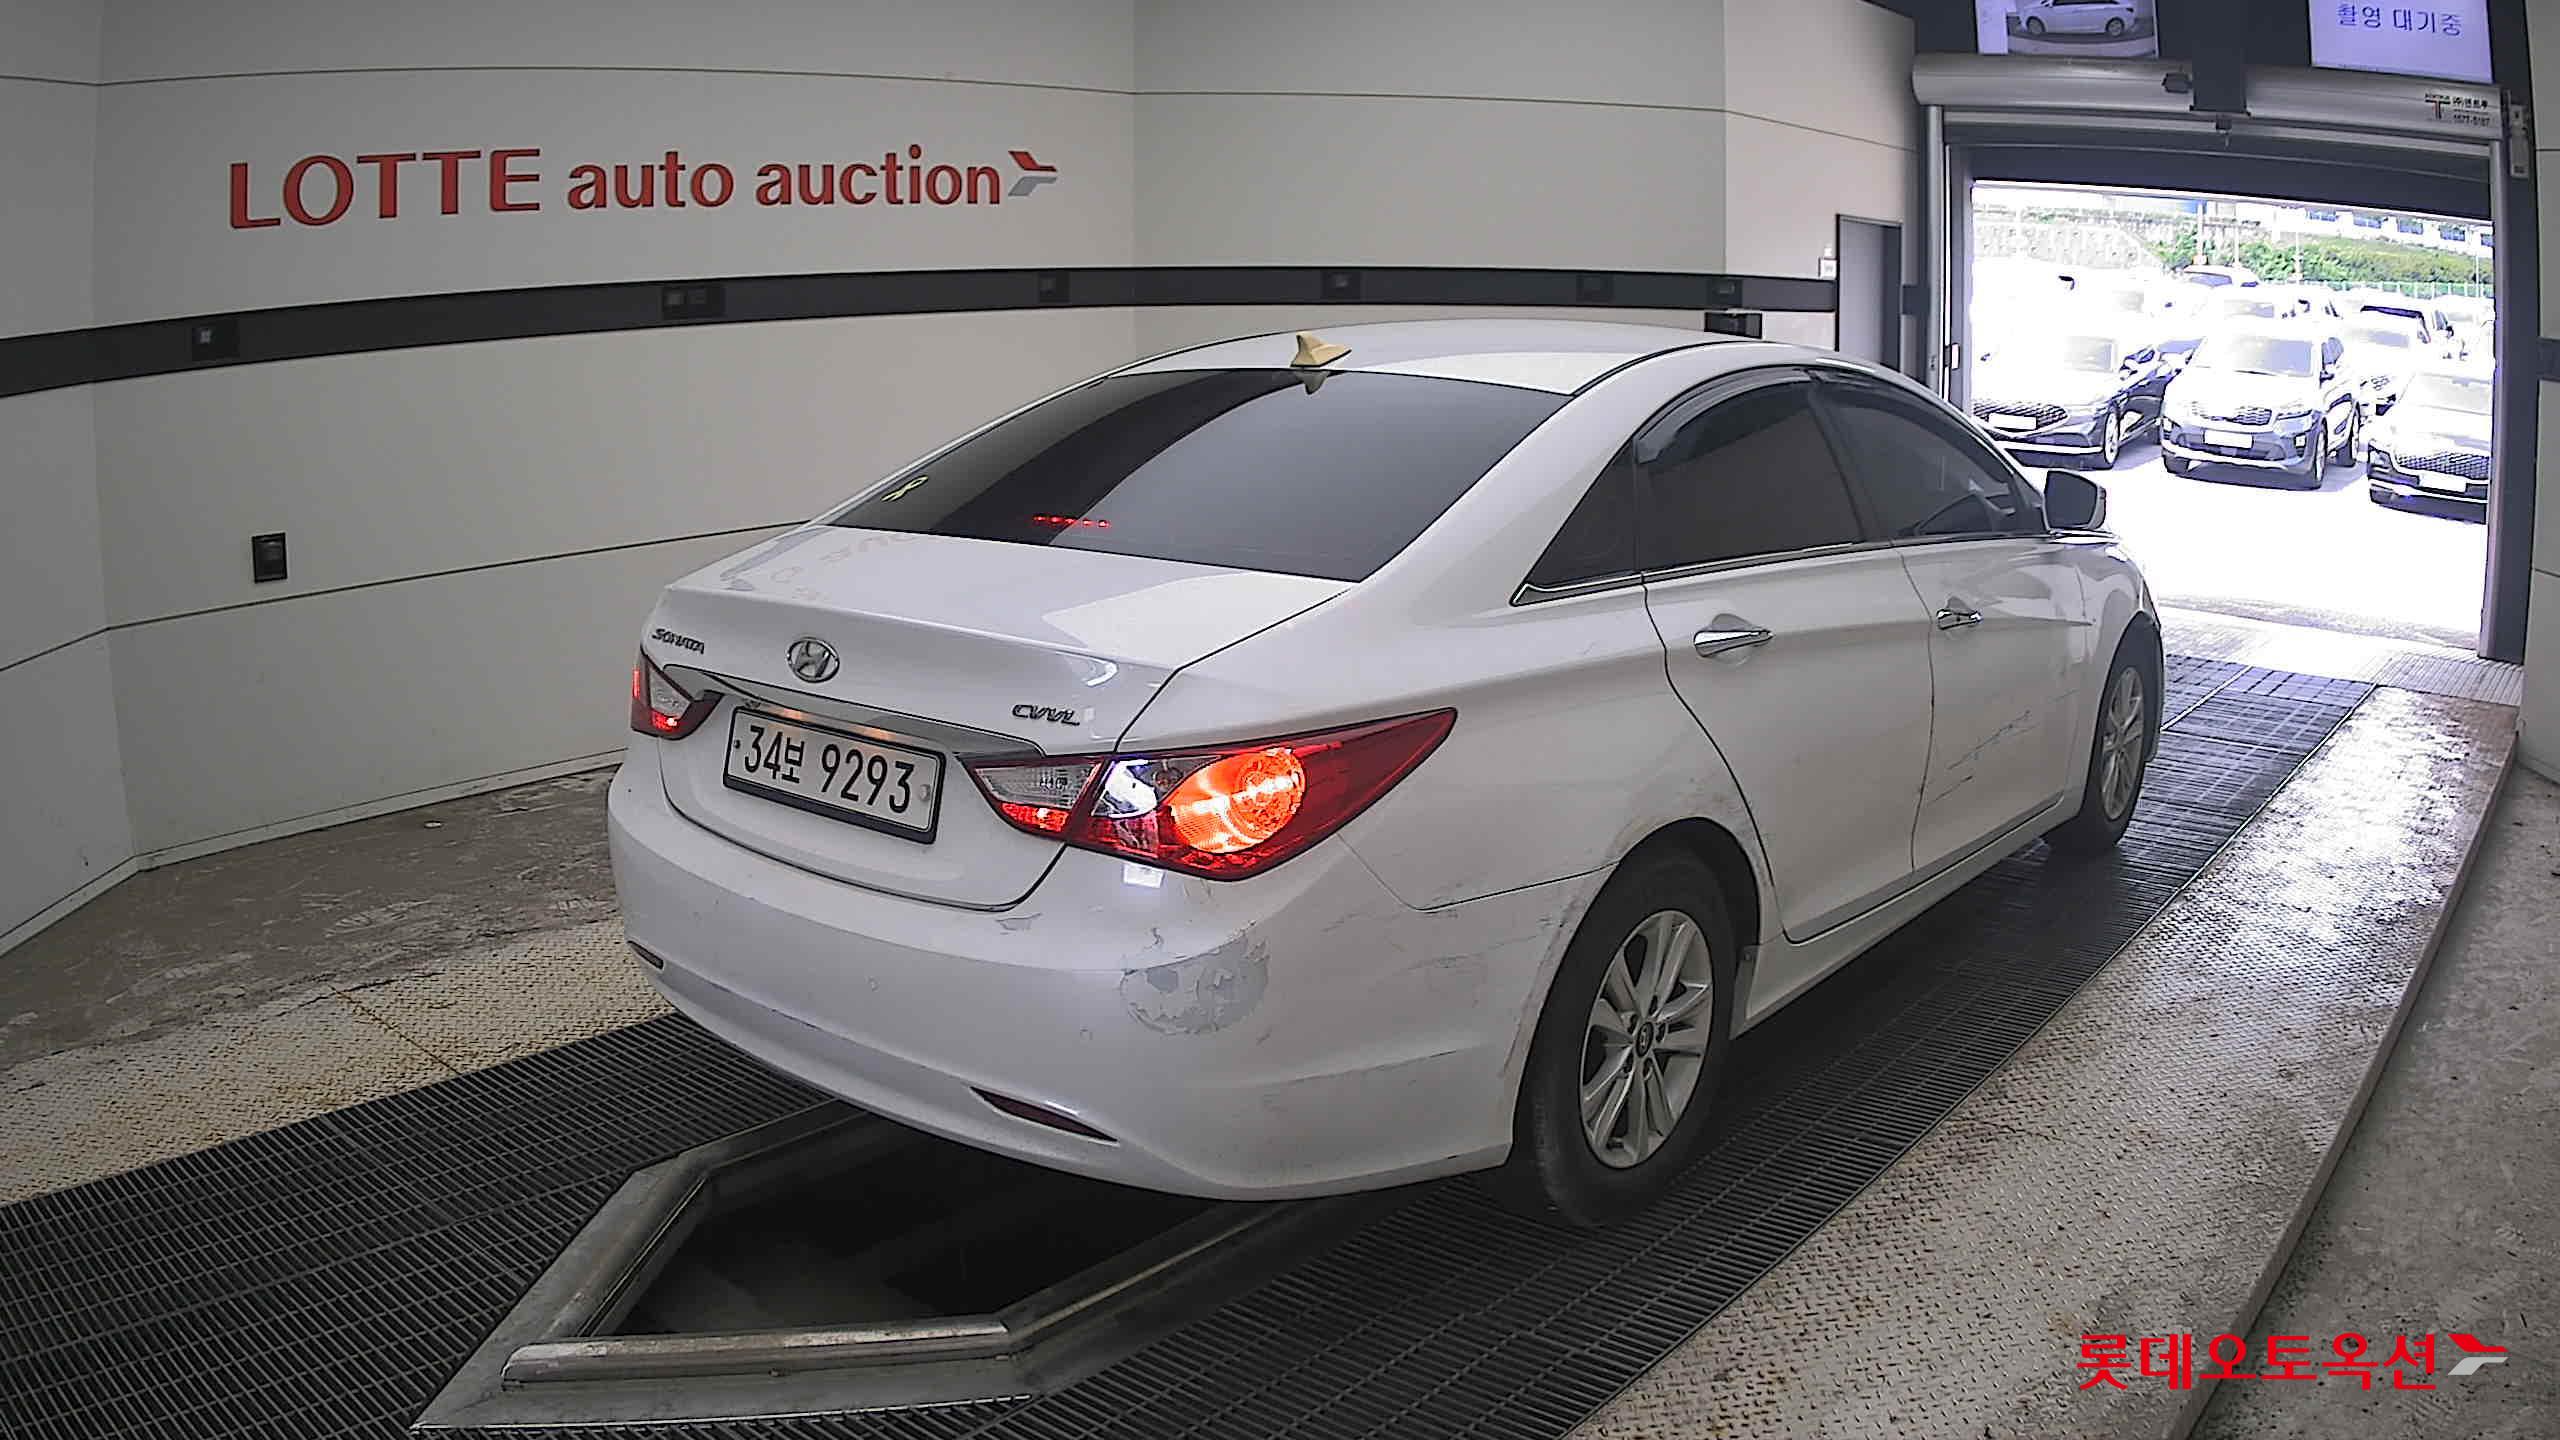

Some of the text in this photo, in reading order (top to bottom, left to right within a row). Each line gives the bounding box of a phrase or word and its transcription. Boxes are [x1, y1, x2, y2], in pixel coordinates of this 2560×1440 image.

[2338, 3, 2461, 37] 촬영 대기중
[230, 143, 1001, 229] LOTTE auto auction
[651, 628, 705, 655] SONATA
[744, 724, 915, 814] 34보 9293
